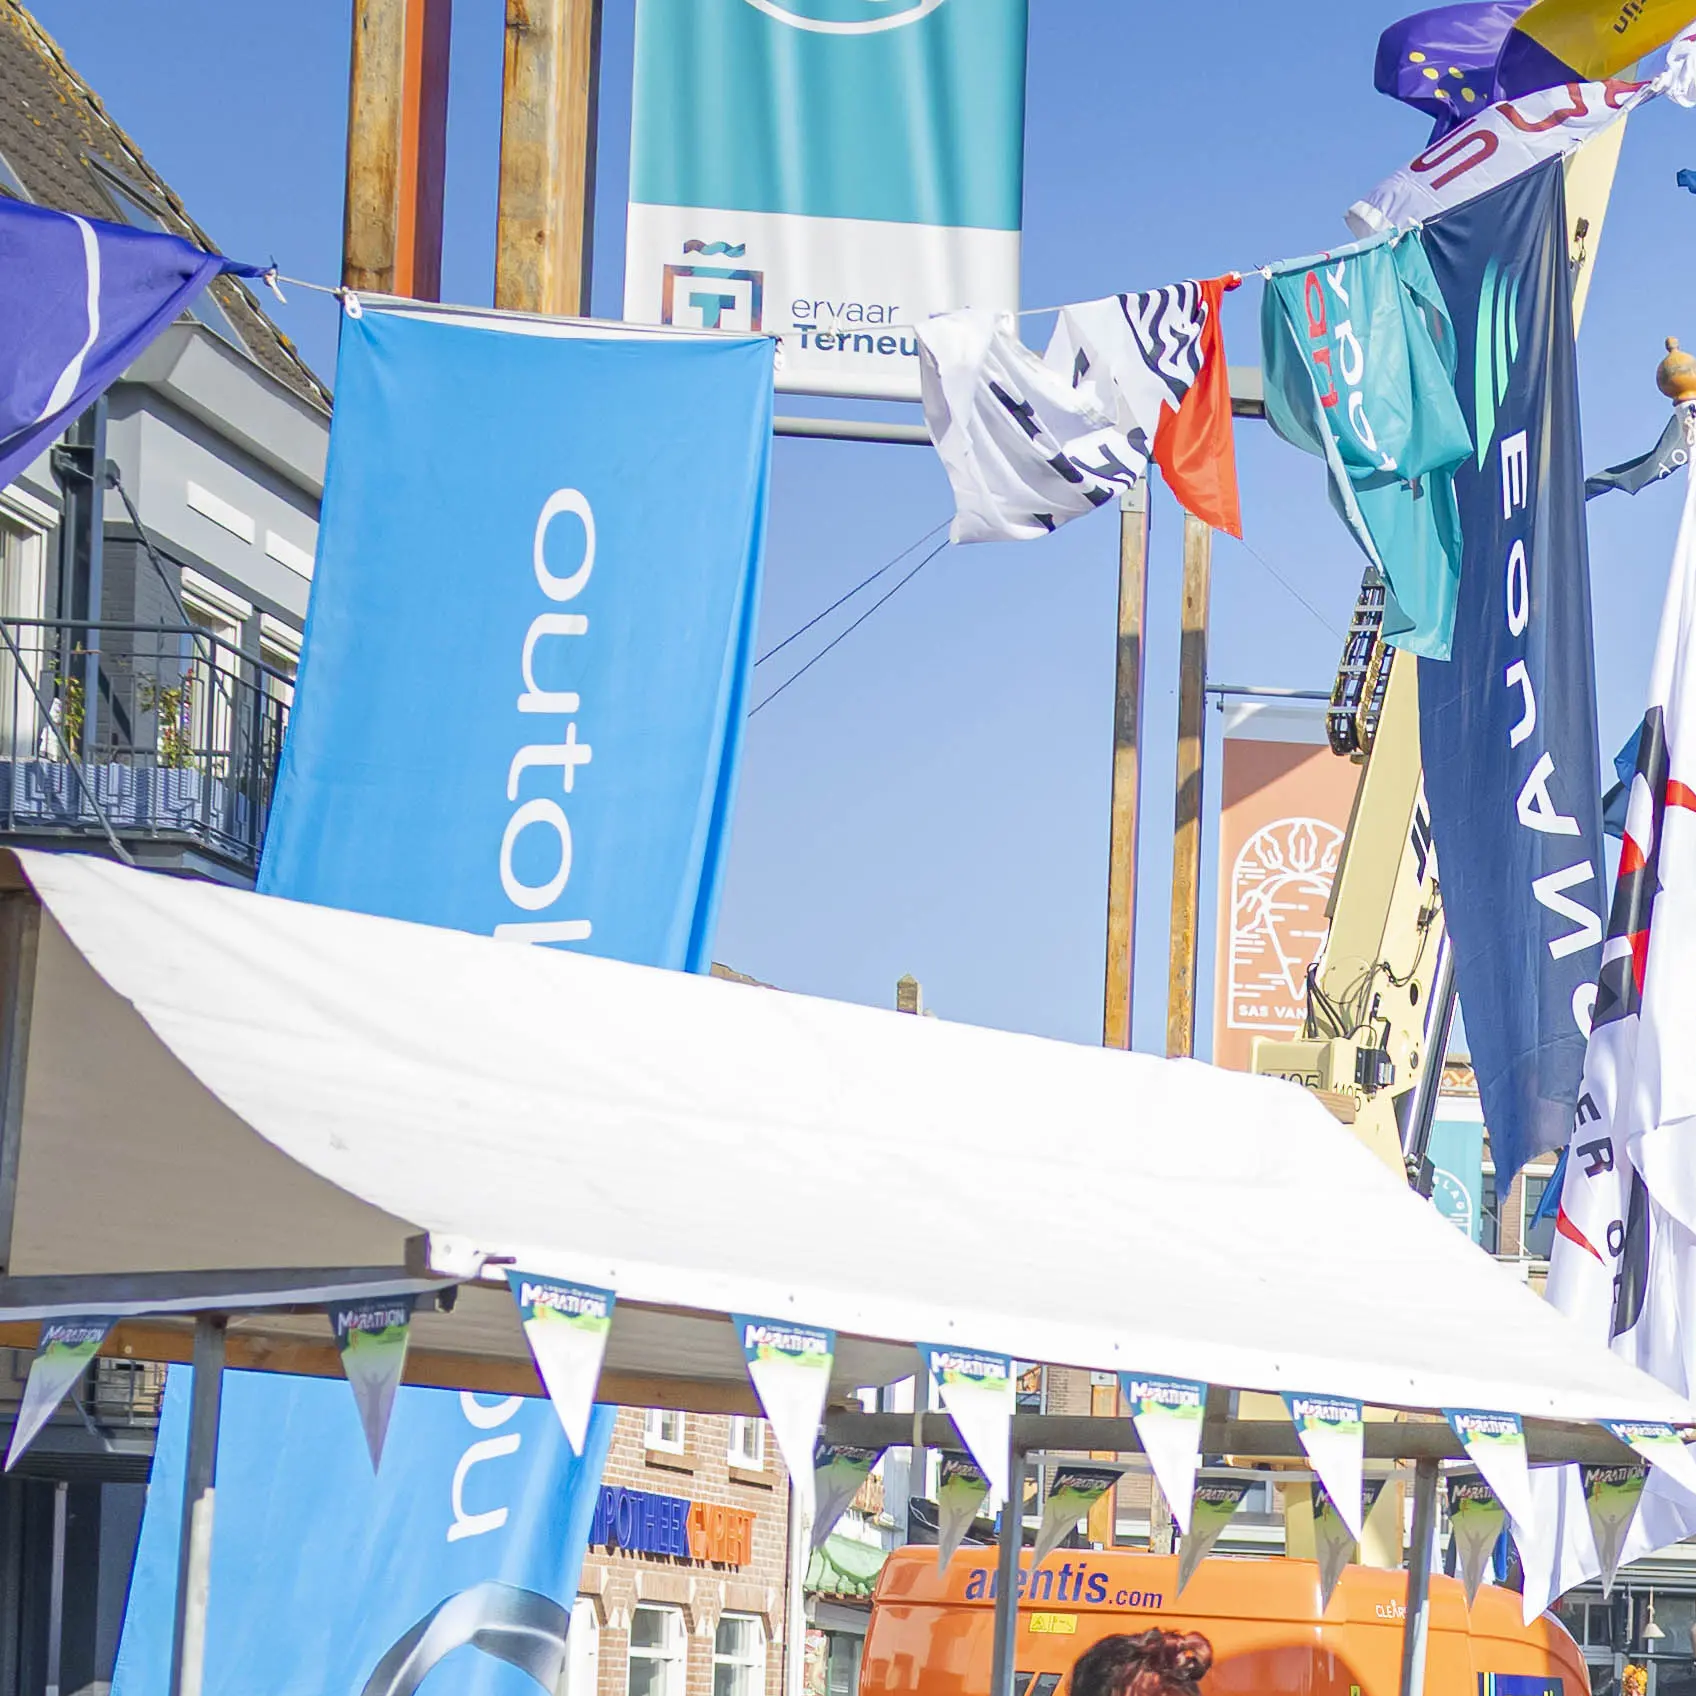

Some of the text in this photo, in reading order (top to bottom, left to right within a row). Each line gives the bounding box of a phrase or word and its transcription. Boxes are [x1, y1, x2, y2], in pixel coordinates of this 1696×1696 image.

[791, 299, 900, 325] ervaar
[792, 323, 920, 356] Terneu
[1238, 1004, 1307, 1020] SAS VAN
